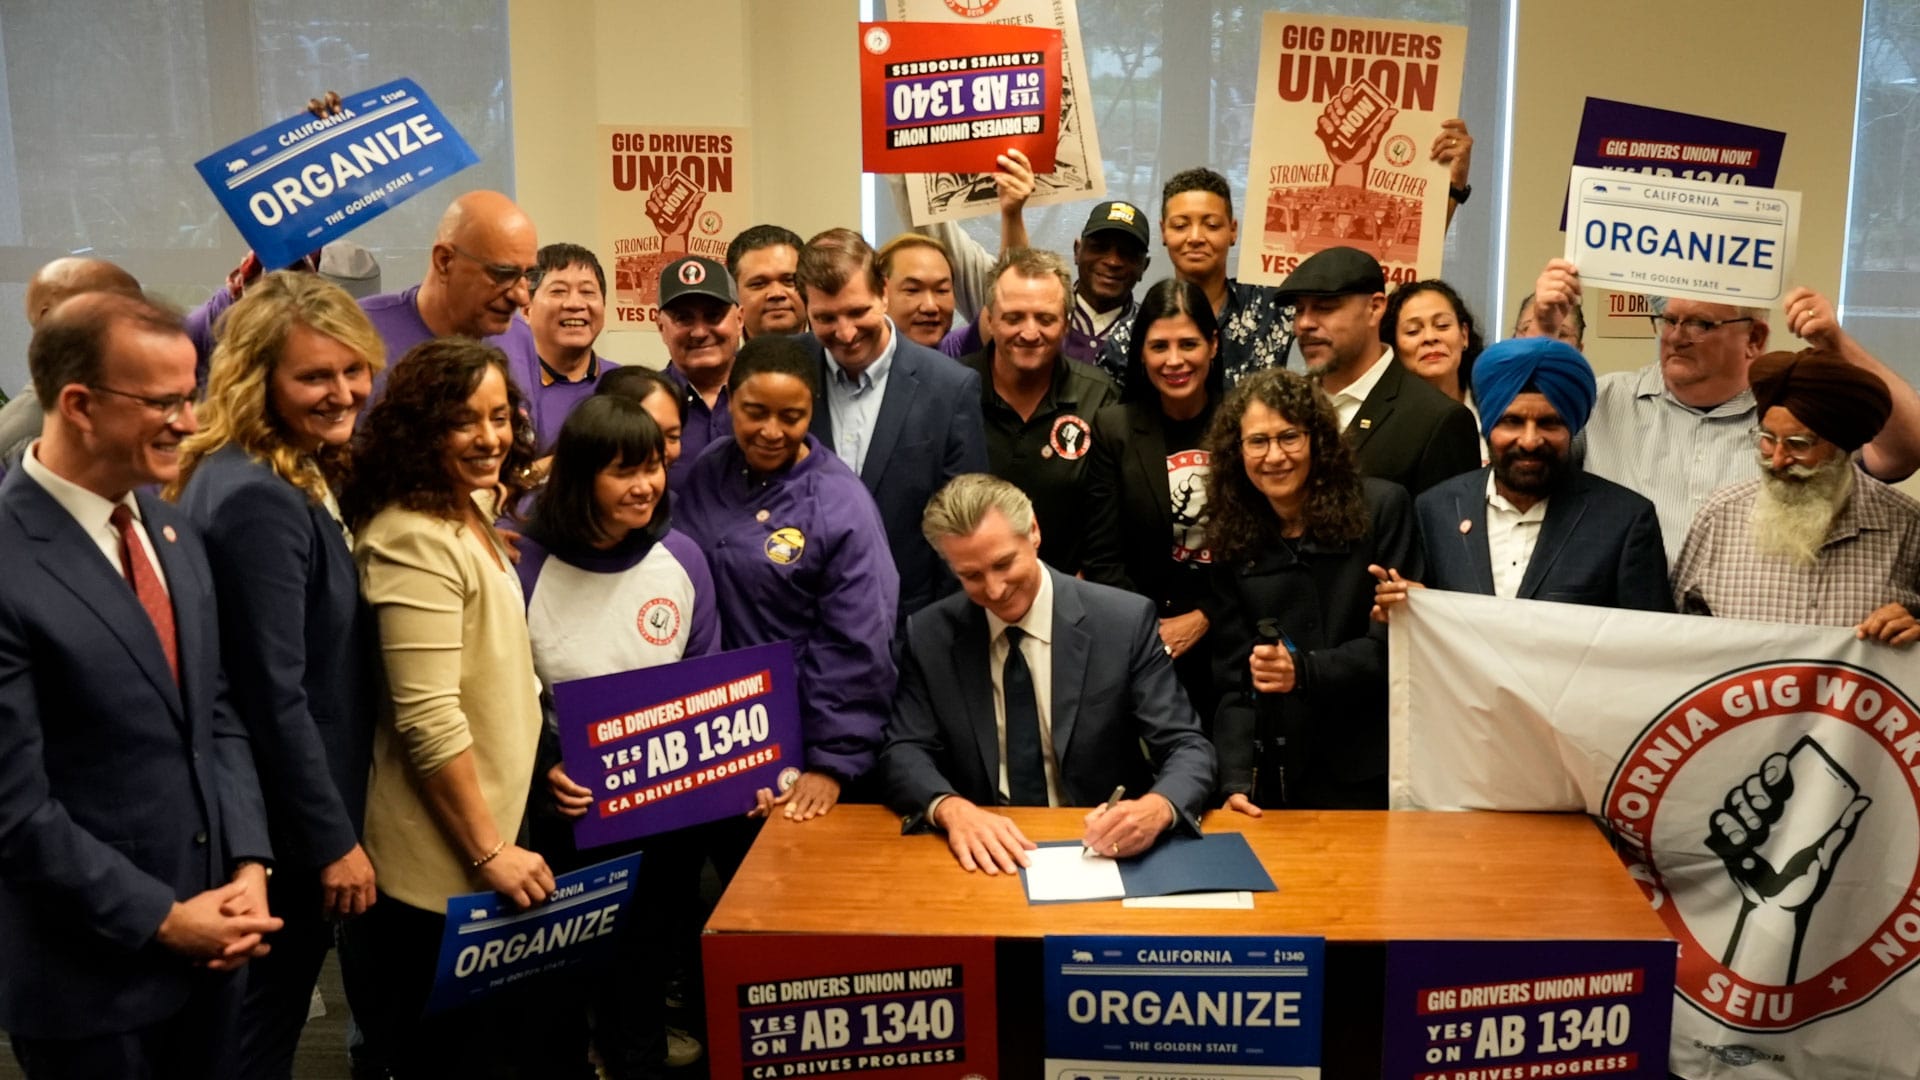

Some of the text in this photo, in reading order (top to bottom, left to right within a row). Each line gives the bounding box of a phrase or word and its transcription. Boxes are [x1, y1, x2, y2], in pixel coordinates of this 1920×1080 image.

[987, 14, 1034, 25] STICE IS
[1282, 24, 1442, 60] GIG DRIVERS
[892, 52, 1039, 76] CA DRIVES PROGRESS
[1016, 72, 1039, 88] ON
[1278, 53, 1439, 112] UNION
[893, 74, 1009, 121] AB 1340
[1010, 90, 1040, 106] YES
[278, 108, 356, 147] CALIFORNIA
[894, 116, 1040, 148] GIG DRIVERS UNION NOW!
[1338, 97, 1376, 138] NOW
[612, 133, 733, 154] GIG DRIVERS
[1606, 140, 1752, 166] GIG DRIVERS UNION NOW!
[249, 114, 444, 227] ORGANIZE
[612, 155, 733, 193] UNION
[1269, 164, 1428, 198] STRONGER TOGETHER
[325, 172, 414, 226] THE GOLDEN STATE
[662, 183, 689, 216] NOW
[1643, 188, 1720, 207] CALIFORNIA
[614, 236, 728, 256] STRONGER TOGETHE
[1585, 219, 1776, 270] ORGANIZE
[1261, 254, 1417, 283] YES 340
[1631, 271, 1720, 290] THE GOLDEN STATE
[616, 307, 645, 321] YES
[1610, 294, 1652, 312] TO DRI
[597, 674, 764, 742] GIG DRIVERS UNION NOW!
[647, 703, 769, 779] AB 1340
[1721, 674, 1801, 718] GIG
[1816, 674, 1920, 788] WORK
[601, 745, 643, 770] YES
[605, 769, 636, 791] ON
[608, 799, 630, 813] CA
[634, 776, 692, 805] DRIVES
[696, 748, 774, 784] PROGRESS
[550, 882, 584, 902] ORNIA
[454, 903, 620, 979] ORGANIZE
[1137, 949, 1233, 963] CALIFORNIA
[747, 967, 953, 1005] GIG DRIVERS UNION NOW!
[1427, 972, 1634, 1012] GIG DRIVERS UNION NOW!
[1701, 971, 1794, 1021] SEIU
[1067, 989, 1301, 1027] ORGANIZE
[751, 1015, 796, 1034] YES
[800, 998, 955, 1051] AB 1340
[1427, 1022, 1472, 1041] YES
[1474, 1004, 1631, 1060] AB 1340
[751, 1038, 787, 1056] ON
[1129, 1041, 1238, 1053] THE GOLDEN STATE
[1425, 1046, 1461, 1064] ON
[752, 1049, 956, 1079] CA DRIVES PROGRESS
[1455, 1056, 1628, 1080] DRIVES PROGRESS
